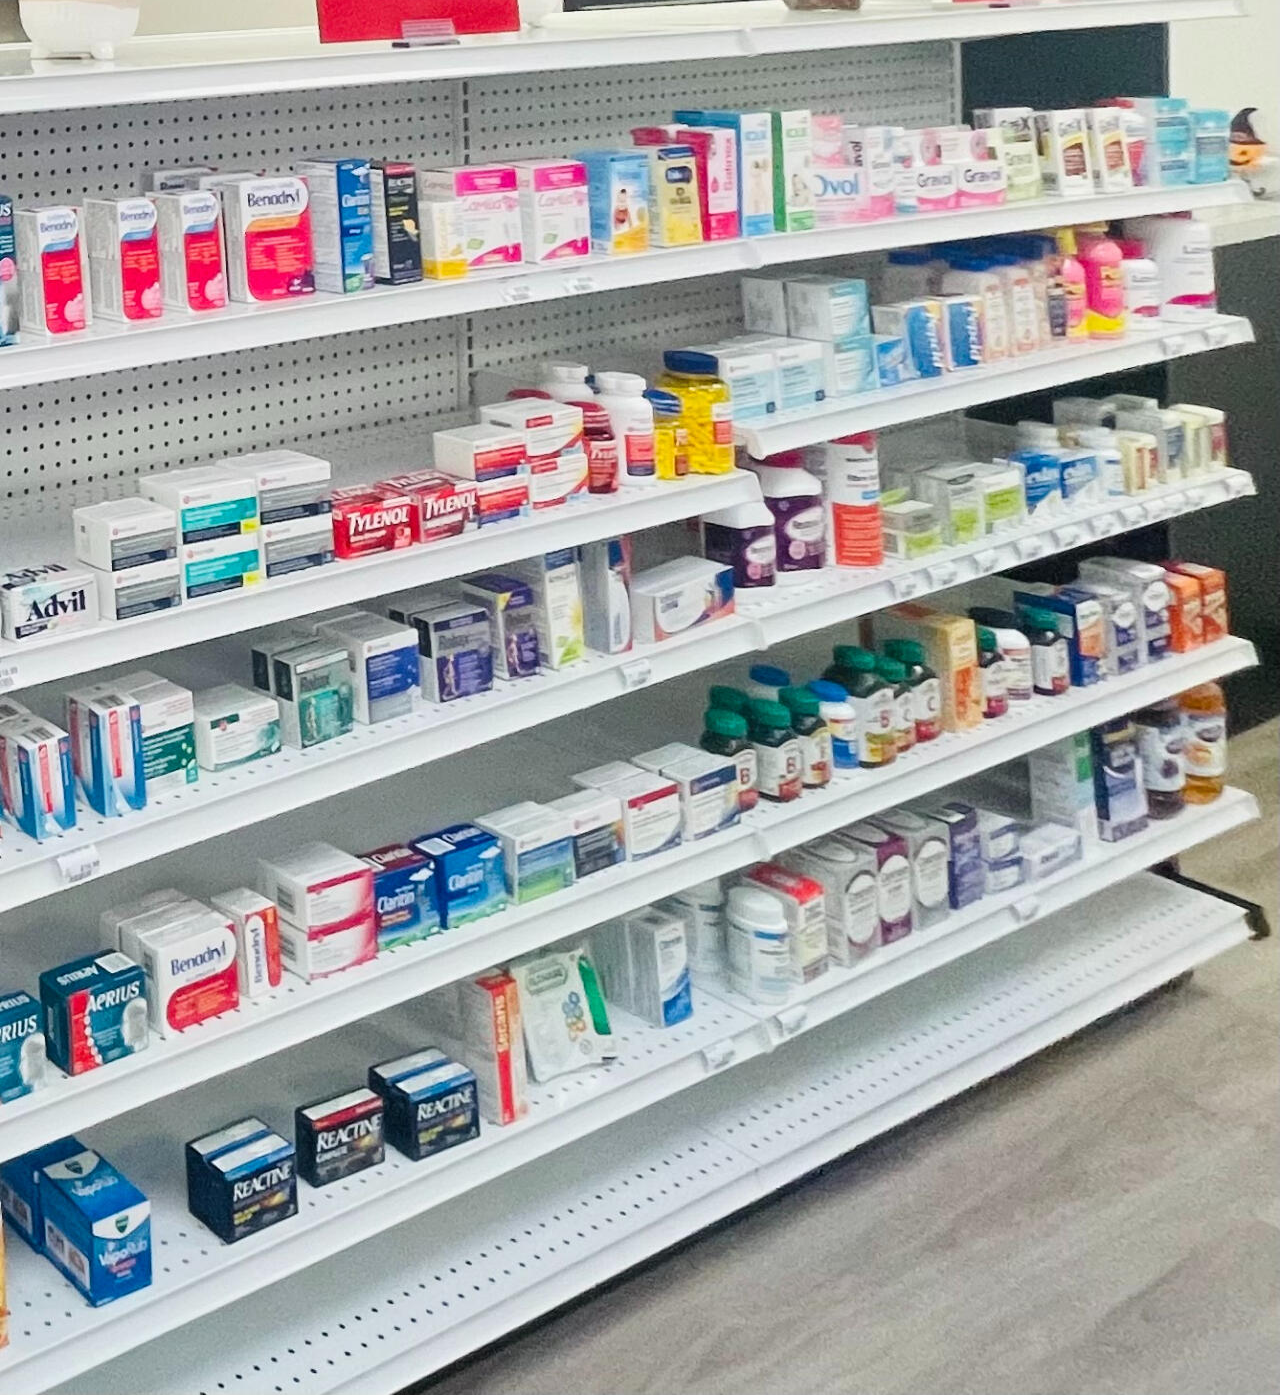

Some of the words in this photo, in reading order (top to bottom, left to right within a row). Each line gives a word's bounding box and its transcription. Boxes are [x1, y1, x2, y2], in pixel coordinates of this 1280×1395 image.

[964, 169, 1002, 184] Gravol
[247, 190, 300, 208] Benadryl
[424, 491, 477, 519] TYLENOL
[347, 506, 410, 533] TYLENOL
[25, 590, 86, 623] Advil
[448, 870, 484, 891] Claritin
[378, 892, 415, 913] Claritin
[169, 941, 227, 976] Benadryl
[253, 925, 265, 985] Benadryl
[417, 1087, 472, 1121] REACTINE
[316, 1114, 382, 1153] REACTINE
[233, 1163, 291, 1201] REACTINE
[99, 1239, 147, 1267] VapoRub
